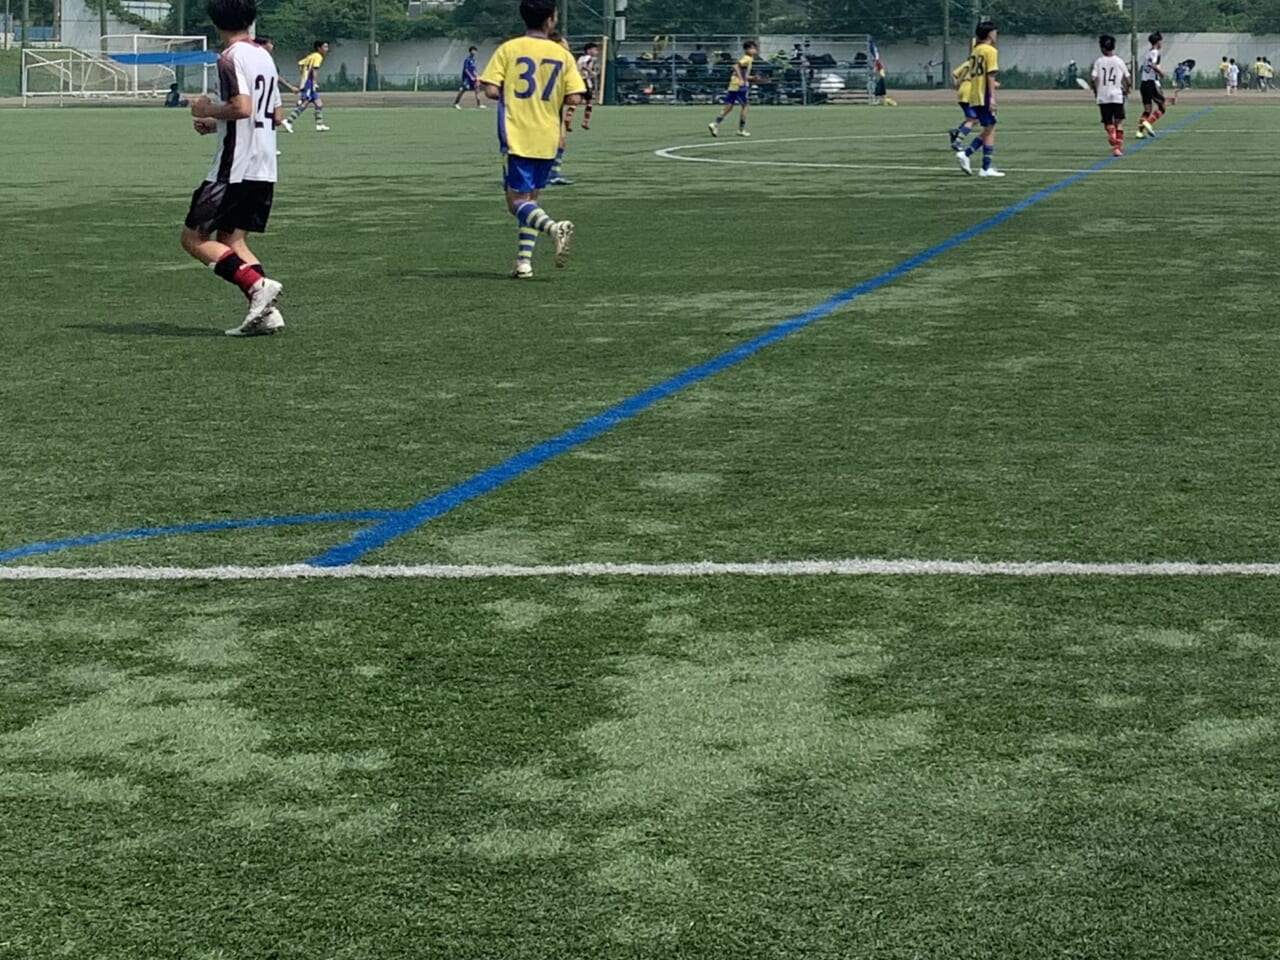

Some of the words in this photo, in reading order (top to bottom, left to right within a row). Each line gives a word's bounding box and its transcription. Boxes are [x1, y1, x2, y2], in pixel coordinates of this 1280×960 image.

[514, 56, 564, 101] 37
[968, 55, 985, 77] 28
[1102, 67, 1117, 86] 14
[254, 74, 276, 131] 24
